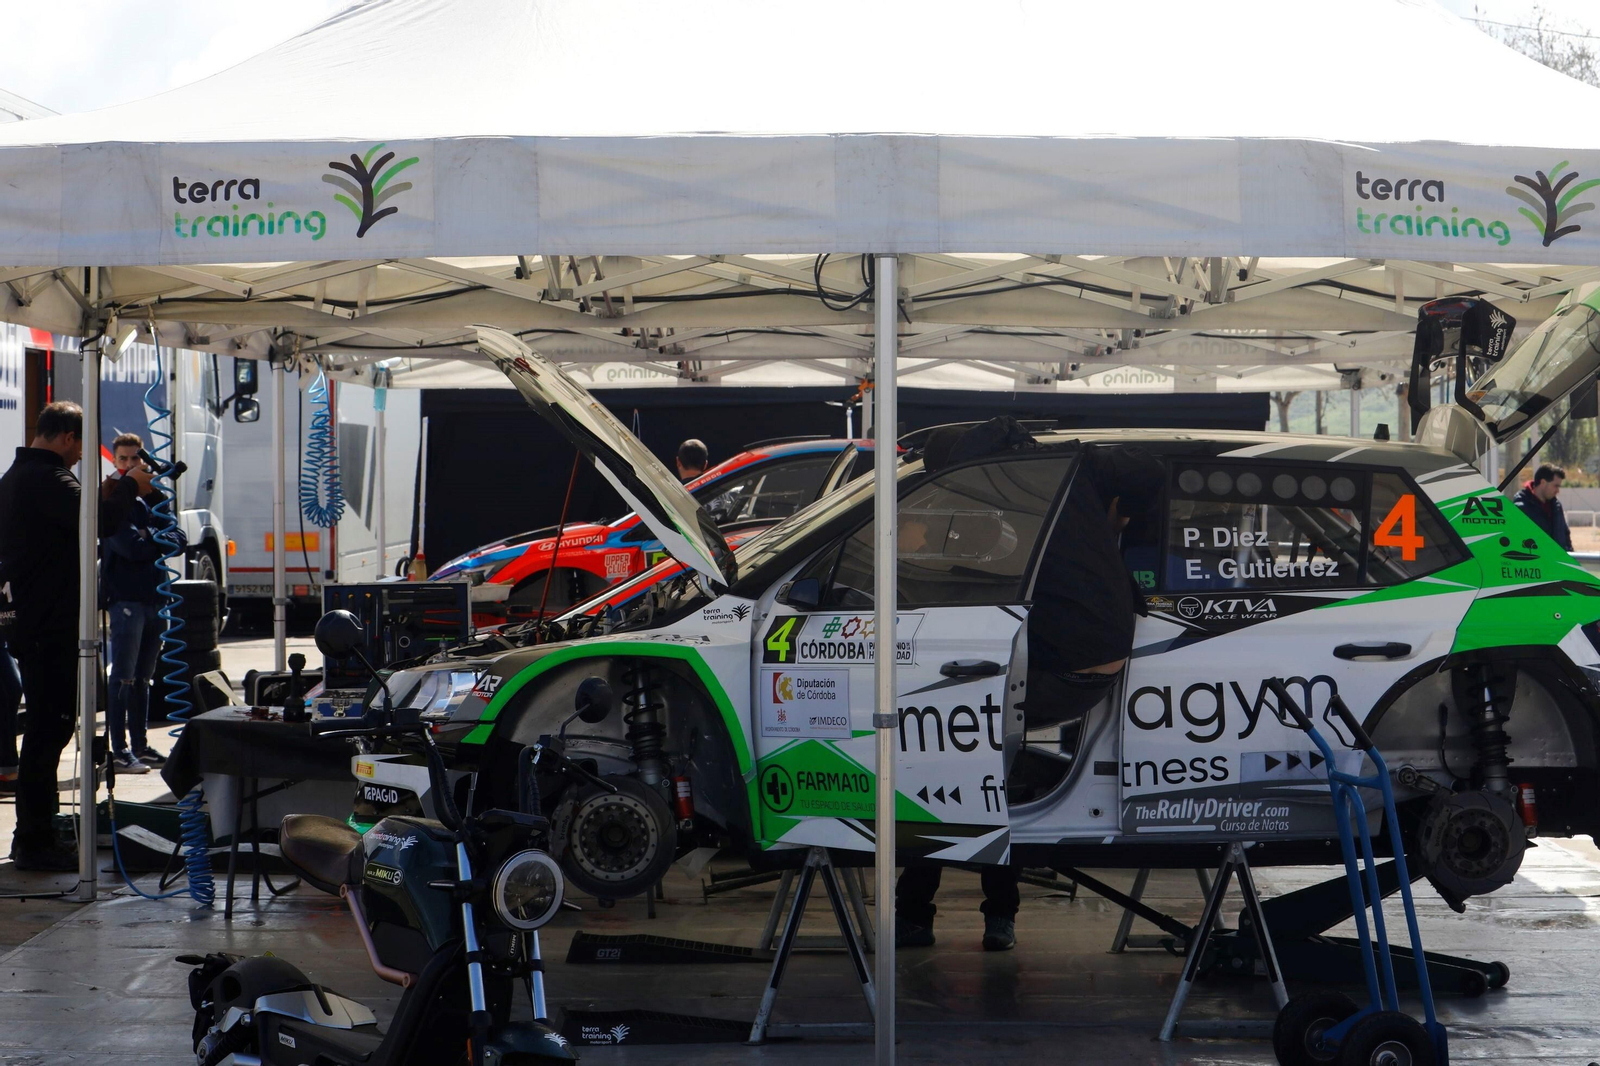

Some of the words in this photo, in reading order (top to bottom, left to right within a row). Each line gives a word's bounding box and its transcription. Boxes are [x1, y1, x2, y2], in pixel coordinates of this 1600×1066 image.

[173, 176, 260, 204] terra
[1356, 171, 1444, 202] terra
[175, 202, 326, 240] training
[1357, 205, 1511, 246] training
[1492, 328, 1504, 356] training
[1462, 497, 1505, 517] AR
[1374, 494, 1424, 561] 4
[558, 534, 603, 548] HYUNDAI
[1184, 527, 1205, 547] P.
[1213, 527, 1269, 547] Diez
[606, 554, 630, 566] UPPER
[607, 563, 627, 573] CLUB
[1186, 559, 1210, 579] E.
[1218, 558, 1339, 579] Gutierrez
[1501, 568, 1513, 578] EL
[1515, 568, 1541, 579] MAZO
[260, 584, 273, 593] KD
[703, 607, 720, 615] terra
[1204, 598, 1277, 614] KTVA
[703, 612, 733, 621] training
[1241, 612, 1278, 620] WEAR
[767, 617, 797, 661] 4
[801, 639, 866, 660] CÓRDOBA
[476, 674, 503, 691] AR
[797, 677, 836, 690] Diputación
[797, 690, 805, 700] de
[806, 688, 836, 700] Córdoba
[1128, 675, 1339, 743] agym
[817, 716, 847, 726] IMDECO
[797, 770, 870, 793] FARMA10
[371, 786, 398, 804] PAGID
[800, 799, 810, 809] TU
[811, 800, 840, 810] ESPACIO
[841, 801, 851, 811] DE
[852, 801, 876, 812] SALUD
[1136, 797, 1289, 824] TheRallyDriver.com
[560, 814, 571, 840] brembo
[1221, 819, 1246, 832] Curso
[1248, 819, 1260, 831] de
[1261, 819, 1289, 831] Notas
[375, 868, 394, 881] MIKU
[582, 1025, 600, 1033] terra
[582, 1030, 612, 1041] training
